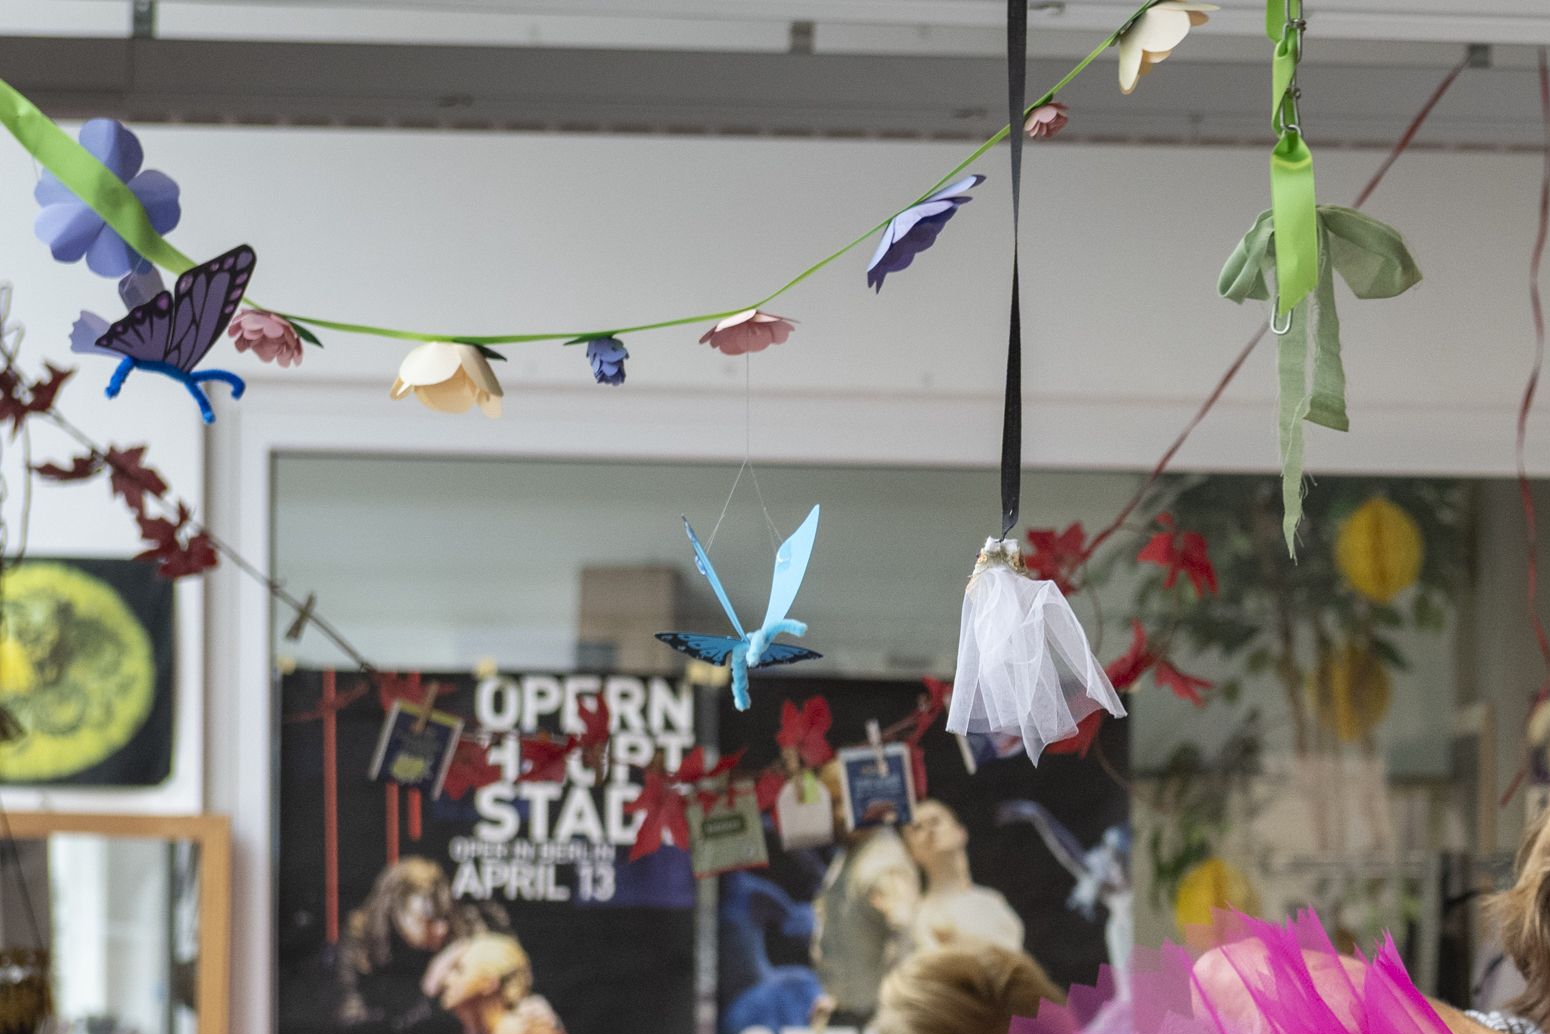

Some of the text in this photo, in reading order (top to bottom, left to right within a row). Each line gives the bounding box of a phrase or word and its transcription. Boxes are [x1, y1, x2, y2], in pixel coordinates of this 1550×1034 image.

[475, 676, 695, 734] OPERN
[452, 862, 616, 900] APRIL 13
